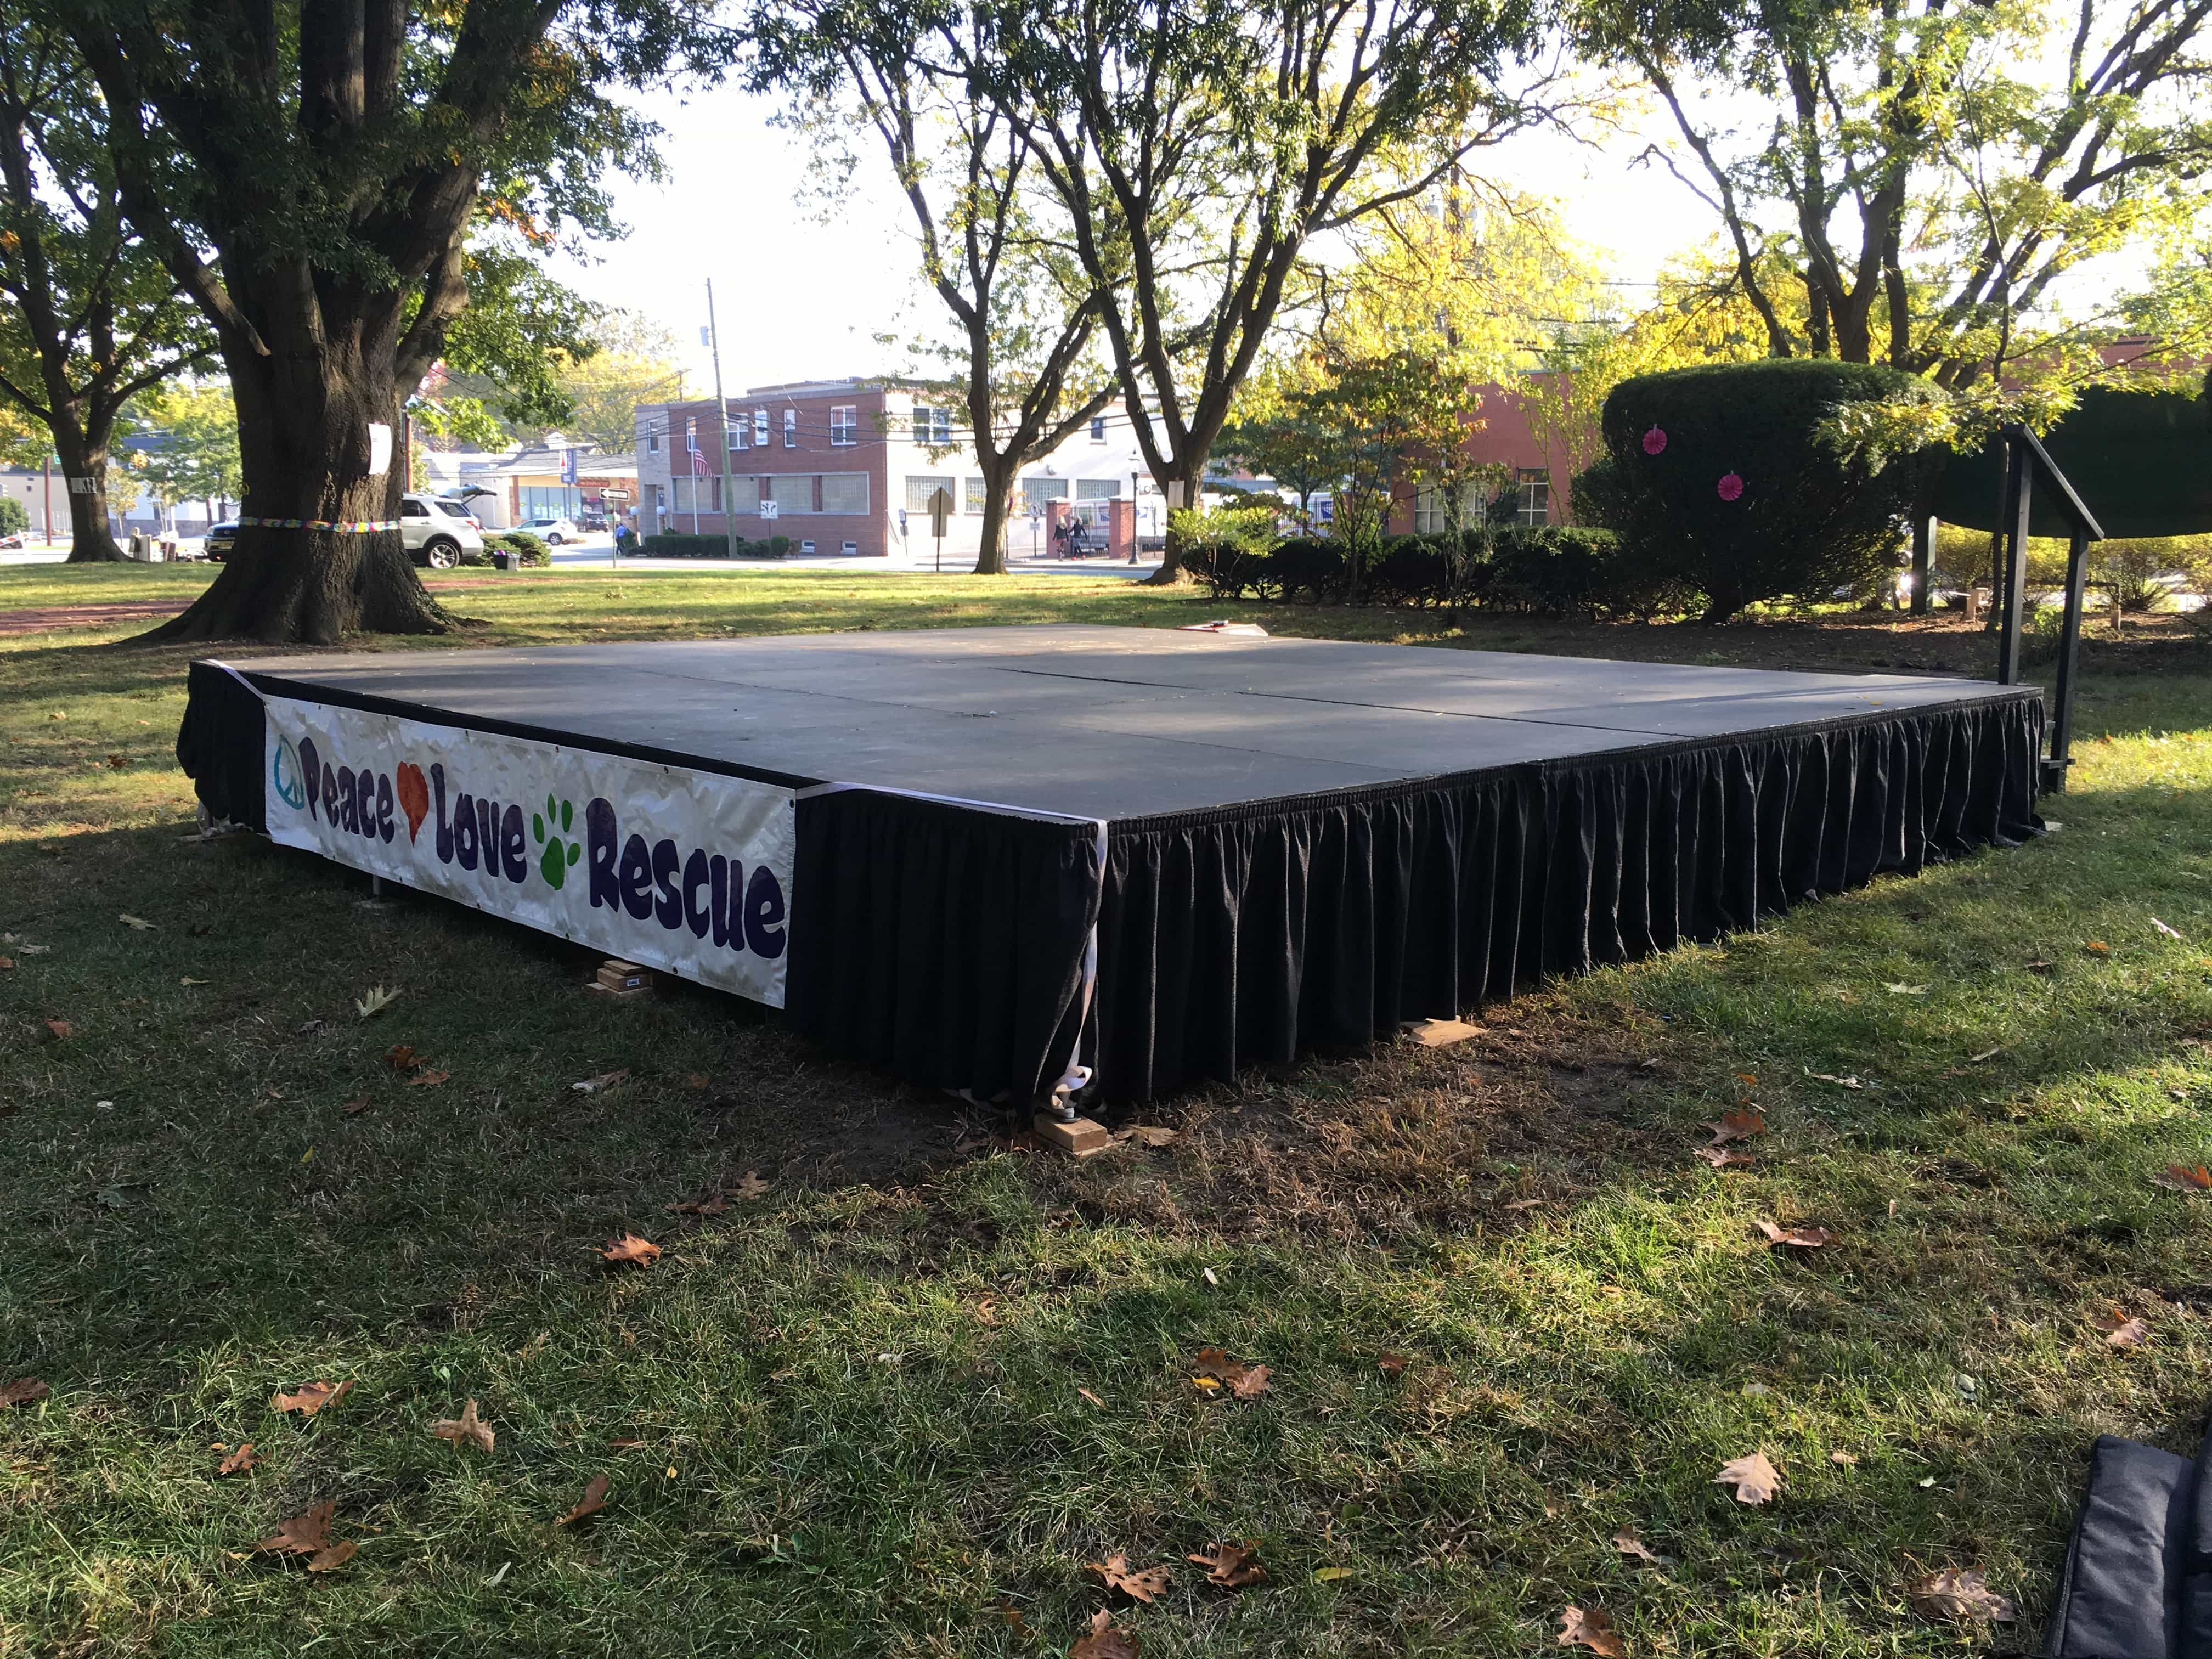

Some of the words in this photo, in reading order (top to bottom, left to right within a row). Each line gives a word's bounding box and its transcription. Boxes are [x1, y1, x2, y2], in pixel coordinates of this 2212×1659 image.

[298, 736, 394, 844] Peace
[430, 763, 527, 884] Love
[586, 797, 786, 960] Rescue
